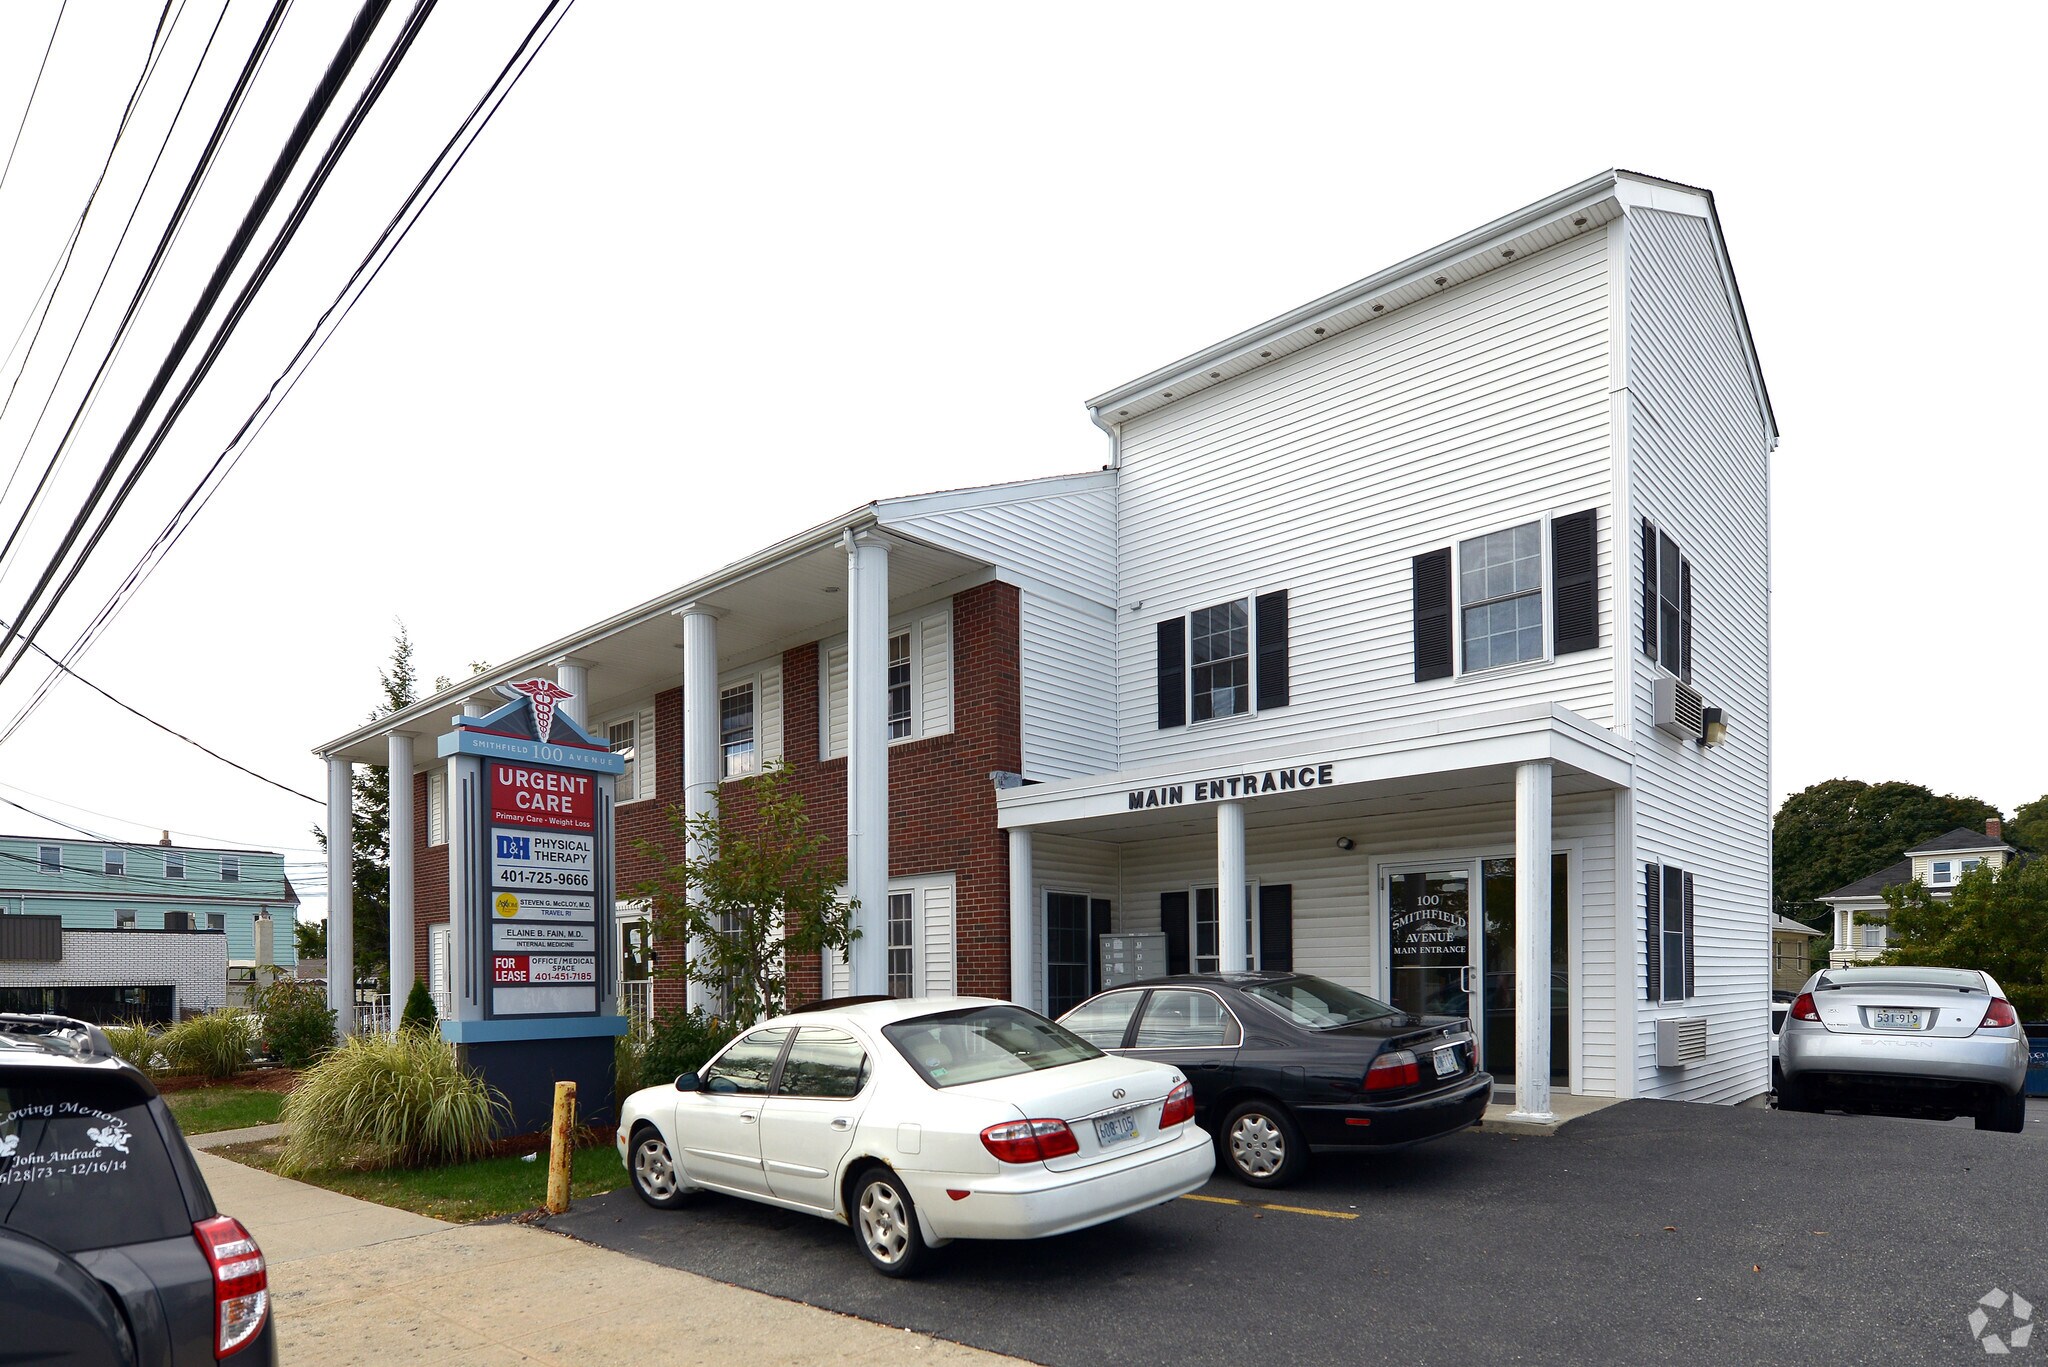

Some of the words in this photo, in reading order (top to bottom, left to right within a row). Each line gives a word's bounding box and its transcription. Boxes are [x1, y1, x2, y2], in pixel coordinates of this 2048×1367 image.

[472, 739, 529, 754] SMITHFIELD
[532, 745, 563, 762] 100
[568, 753, 613, 766] AVENUE
[499, 767, 588, 795] URGENT
[1128, 785, 1183, 810] MAIN
[1194, 764, 1333, 802] ENTRANCE
[515, 790, 573, 814] CARE
[495, 811, 524, 823] Primary
[526, 814, 543, 824] Care
[549, 816, 573, 827] Weight
[575, 819, 591, 828] Loss
[496, 835, 531, 860] D&H
[534, 838, 590, 852] PHYSICAL
[534, 851, 588, 864] THERAPY
[501, 870, 589, 887] 401-725-9666
[520, 899, 544, 907] STEVEN
[1416, 894, 1440, 906] 100
[1392, 909, 1467, 930] SMITHFIELD
[506, 929, 536, 937] ELAINE
[537, 929, 545, 937] B.
[547, 930, 566, 938] FAIN,
[568, 930, 584, 938] M.D.
[1405, 932, 1454, 943] AVENUE
[1394, 946, 1417, 955] MAIN
[1419, 945, 1467, 954] ENTRANCE
[495, 957, 516, 969] FOR
[532, 957, 594, 965] OFFICE/MEDICAL
[495, 970, 527, 982] LEASE
[534, 972, 592, 981] 401-451-7185
[1877, 1013, 1919, 1024] 531-919
[1861, 1039, 1933, 1048] SATURN
[59, 1101, 128, 1128] Memory
[1099, 1116, 1135, 1138] 608-105
[12, 1152, 45, 1168] John
[46, 1147, 102, 1164] Andrade
[71, 1160, 128, 1176] 12/16/14
